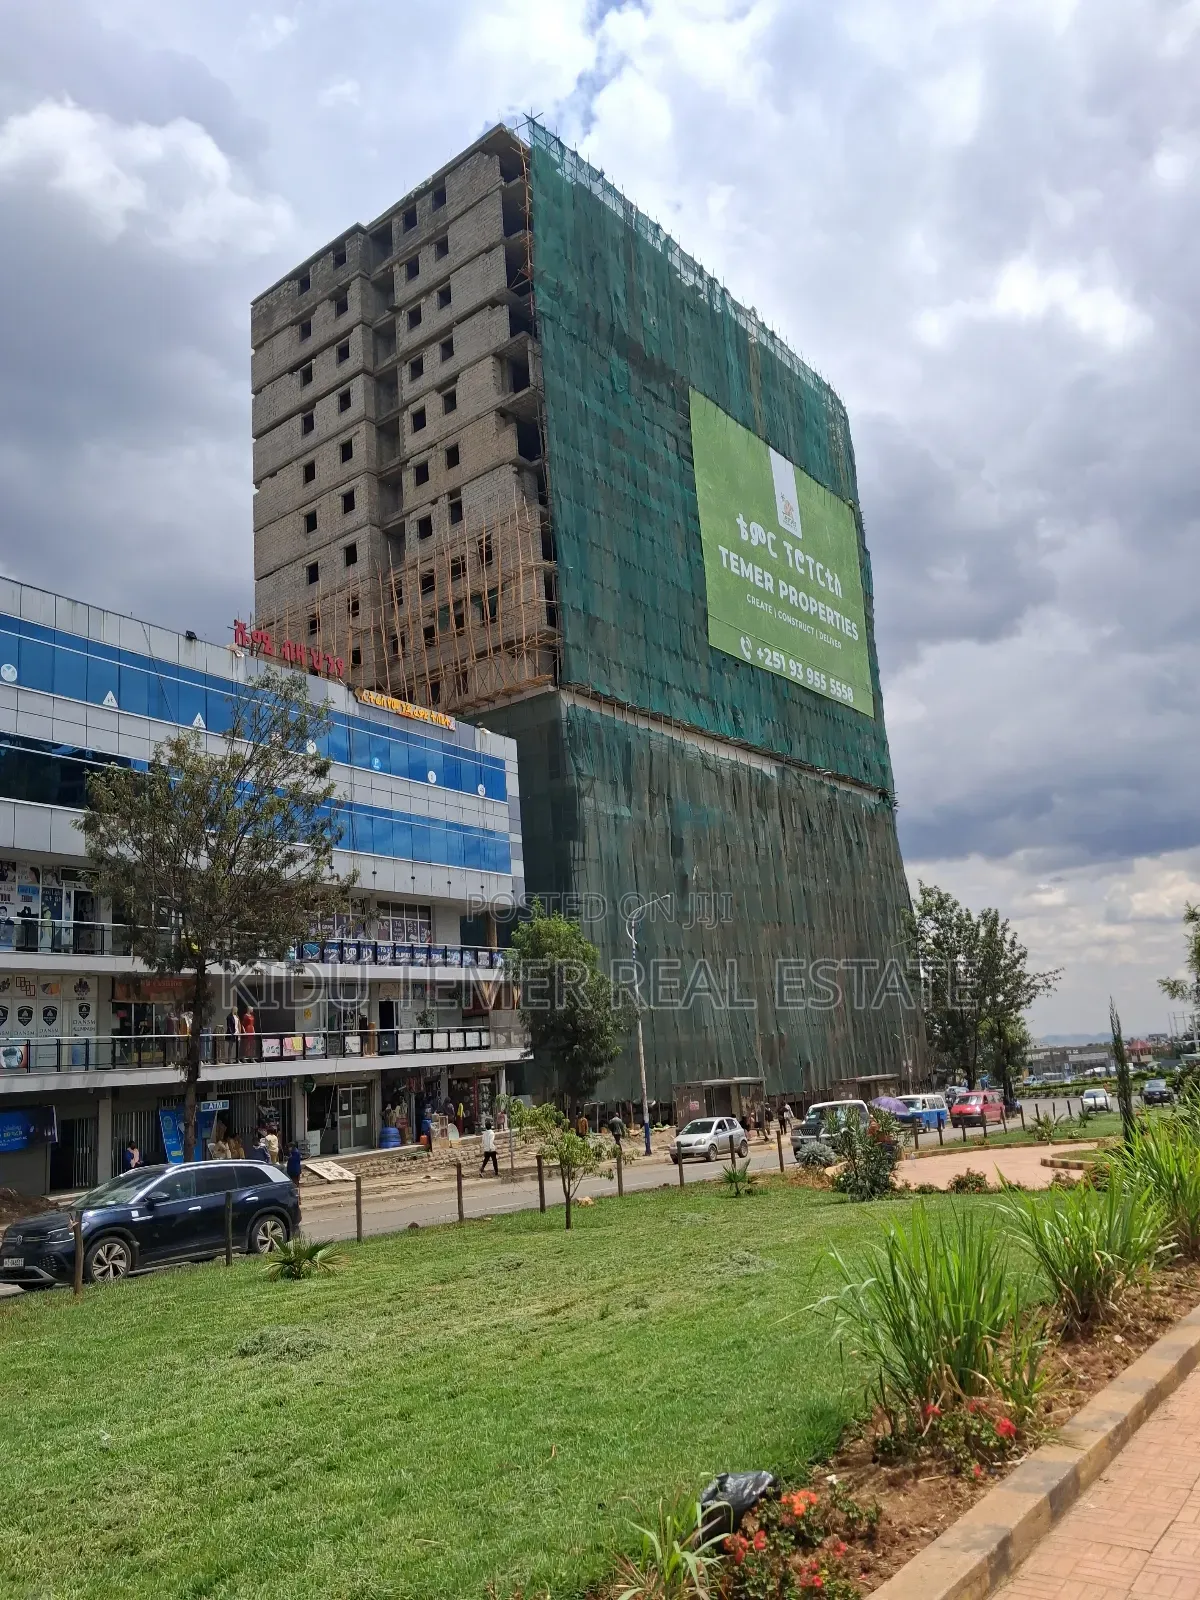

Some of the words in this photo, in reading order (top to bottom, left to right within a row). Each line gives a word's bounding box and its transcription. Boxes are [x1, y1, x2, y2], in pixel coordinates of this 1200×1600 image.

[718, 544, 774, 594] TEMER
[779, 579, 859, 641] PROPERTIES
[746, 594, 773, 616] CREATE
[777, 610, 814, 637] CONSTRUCT
[819, 629, 842, 650] DELIVER
[756, 647, 785, 672] +251
[788, 660, 804, 680] 93
[806, 666, 827, 691] 955
[829, 677, 854, 702] 5558
[208, 1101, 222, 1110] ATM
